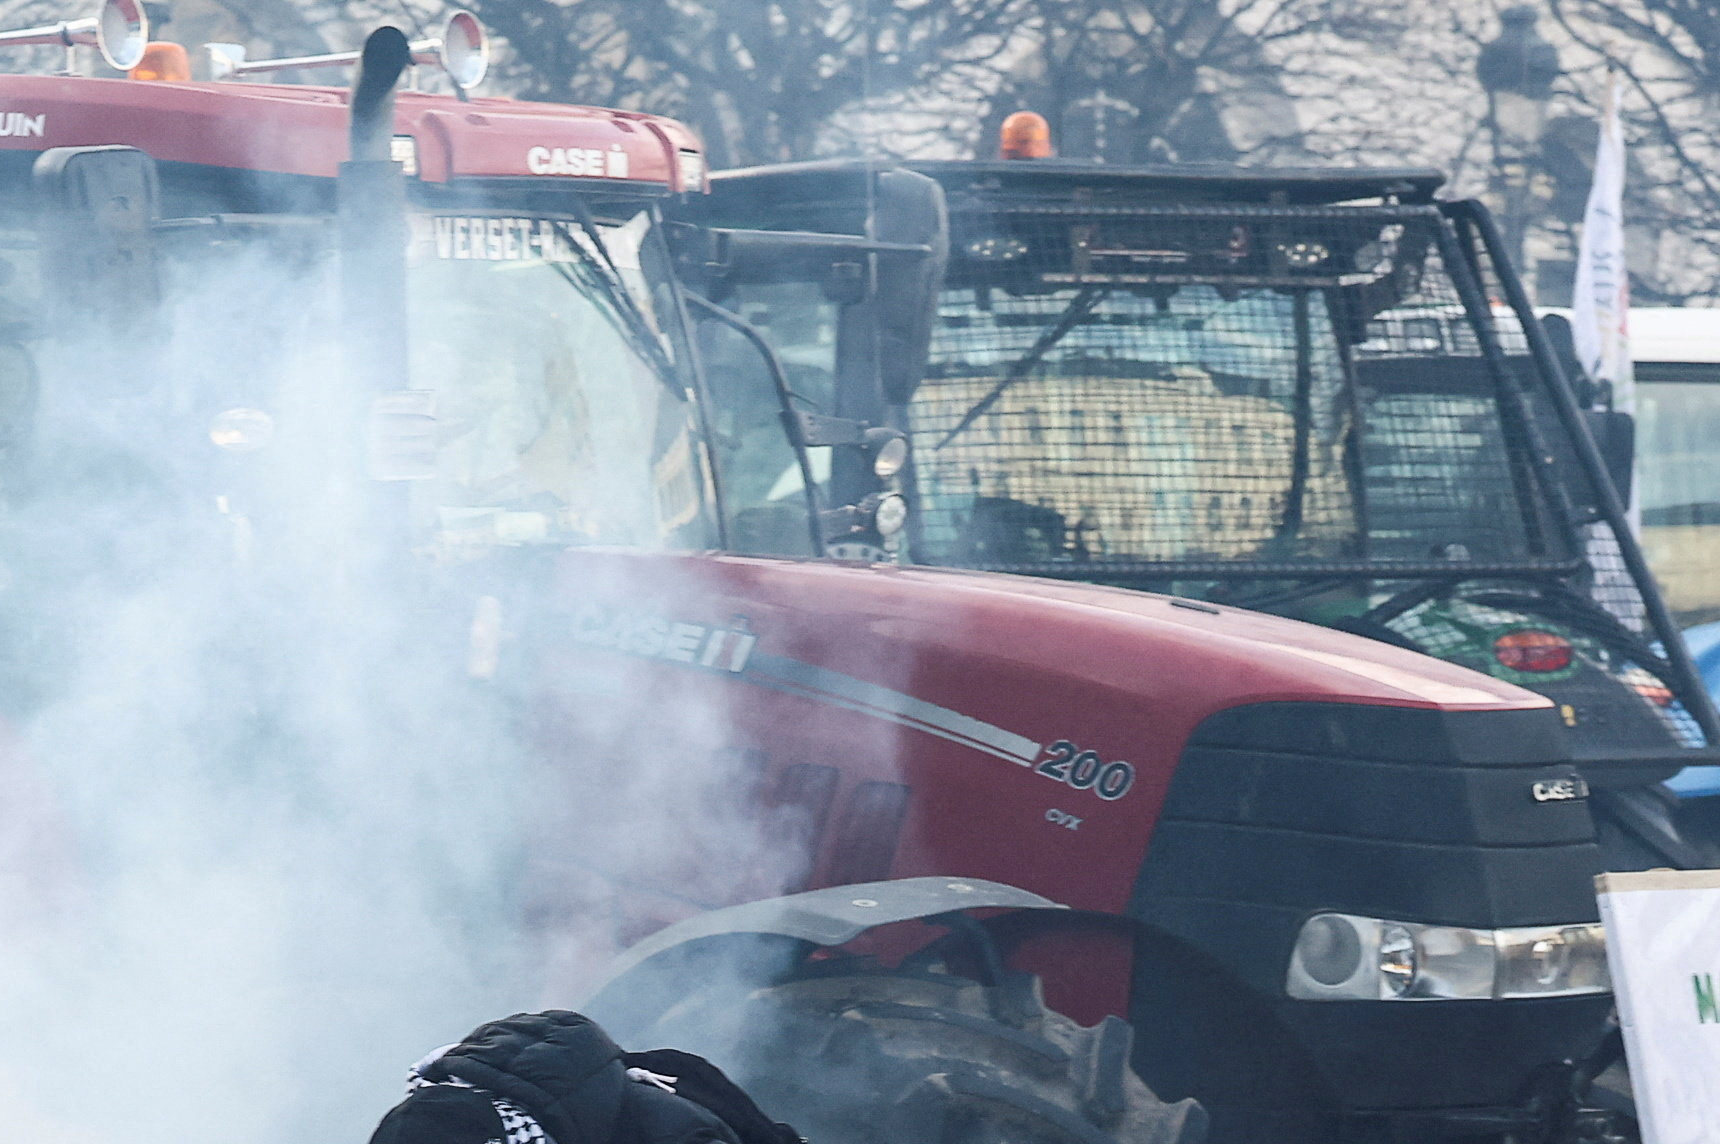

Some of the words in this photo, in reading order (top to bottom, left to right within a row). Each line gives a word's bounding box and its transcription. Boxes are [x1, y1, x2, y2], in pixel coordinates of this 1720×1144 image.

[527, 146, 605, 176] CASE
[1035, 739, 1136, 801] 200
[1045, 808, 1083, 831] CVX
